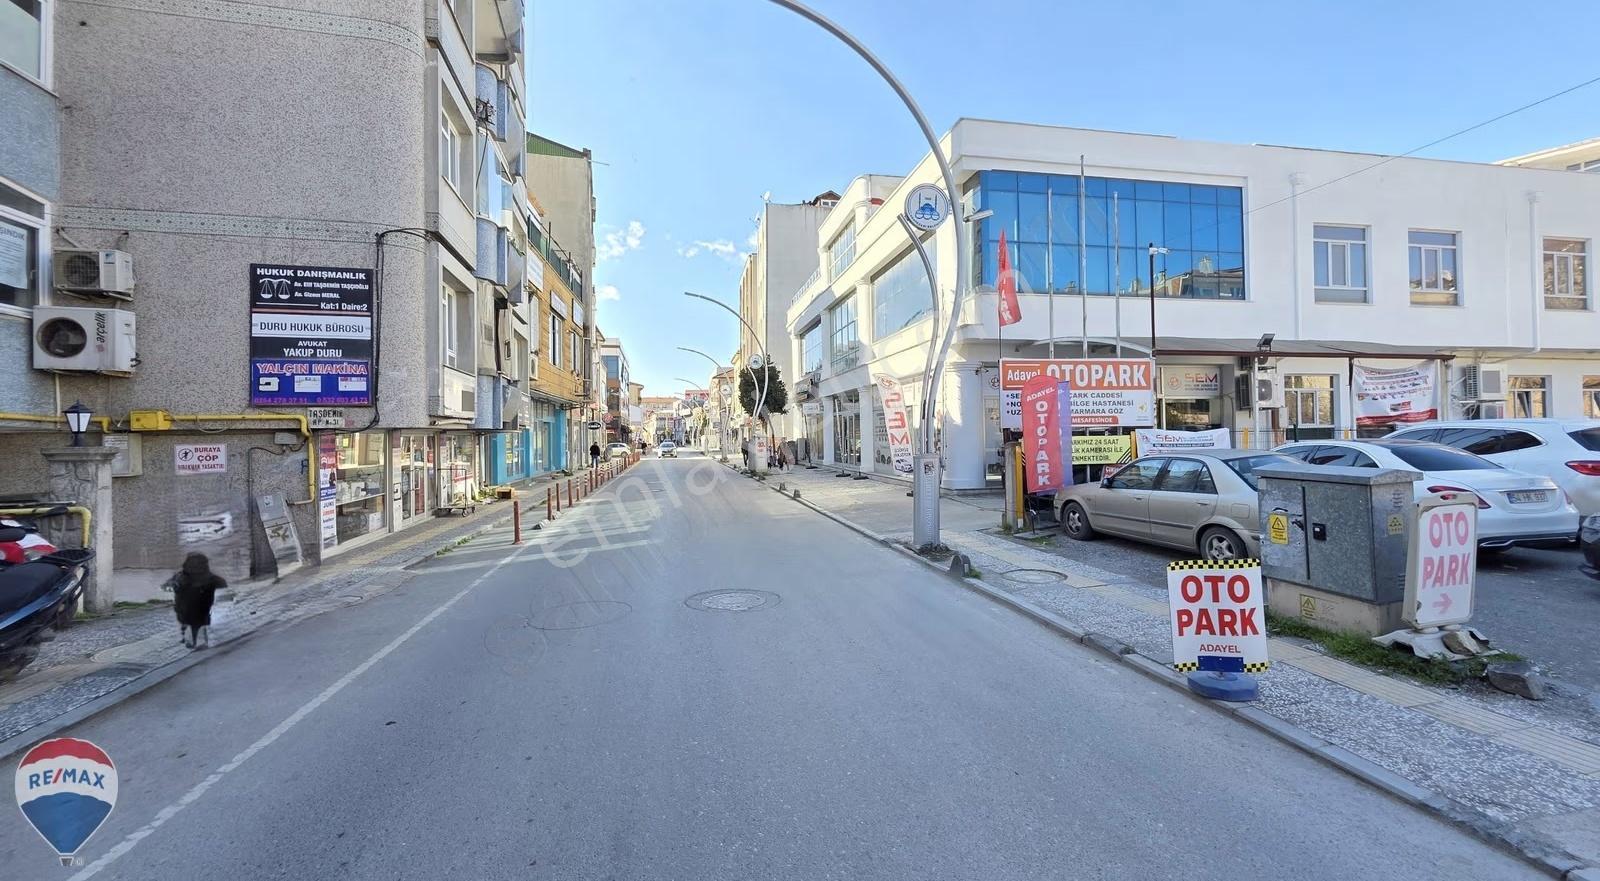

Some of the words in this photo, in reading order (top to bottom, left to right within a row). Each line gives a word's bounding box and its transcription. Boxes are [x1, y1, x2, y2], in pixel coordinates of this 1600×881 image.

[257, 268, 294, 278] HUKUK
[297, 269, 366, 280] DANIŞMANLIK
[320, 302, 340, 310] Kat:1
[341, 302, 368, 311] Daire:2
[95, 311, 106, 343] arçelik
[260, 321, 287, 331] DURU
[289, 322, 323, 332] HUKUK
[325, 322, 365, 333] BÜROSU
[297, 340, 328, 348] AVUKAT
[283, 348, 315, 358] YAKUP
[316, 348, 343, 358] DURU
[255, 363, 309, 376] YALÇIN
[312, 362, 369, 375] MAKİNA
[1046, 364, 1147, 388] OTOPARK
[1184, 372, 1218, 384] SEM
[1026, 387, 1055, 402] ADAYEL
[1108, 407, 1125, 415] GÖZ
[1071, 416, 1114, 424] MESAFESİNDE
[1035, 400, 1050, 486] OTOPARK
[1081, 446, 1113, 454] KAMERASI
[196, 454, 219, 464] ÇÖP
[1072, 454, 1112, 462] ENMEKTEDİR.
[1428, 512, 1469, 548] OTO
[1422, 552, 1471, 590] PARK
[1180, 574, 1250, 604] OTO
[1176, 607, 1260, 638] PARK
[1198, 644, 1242, 654] ADAYEL
